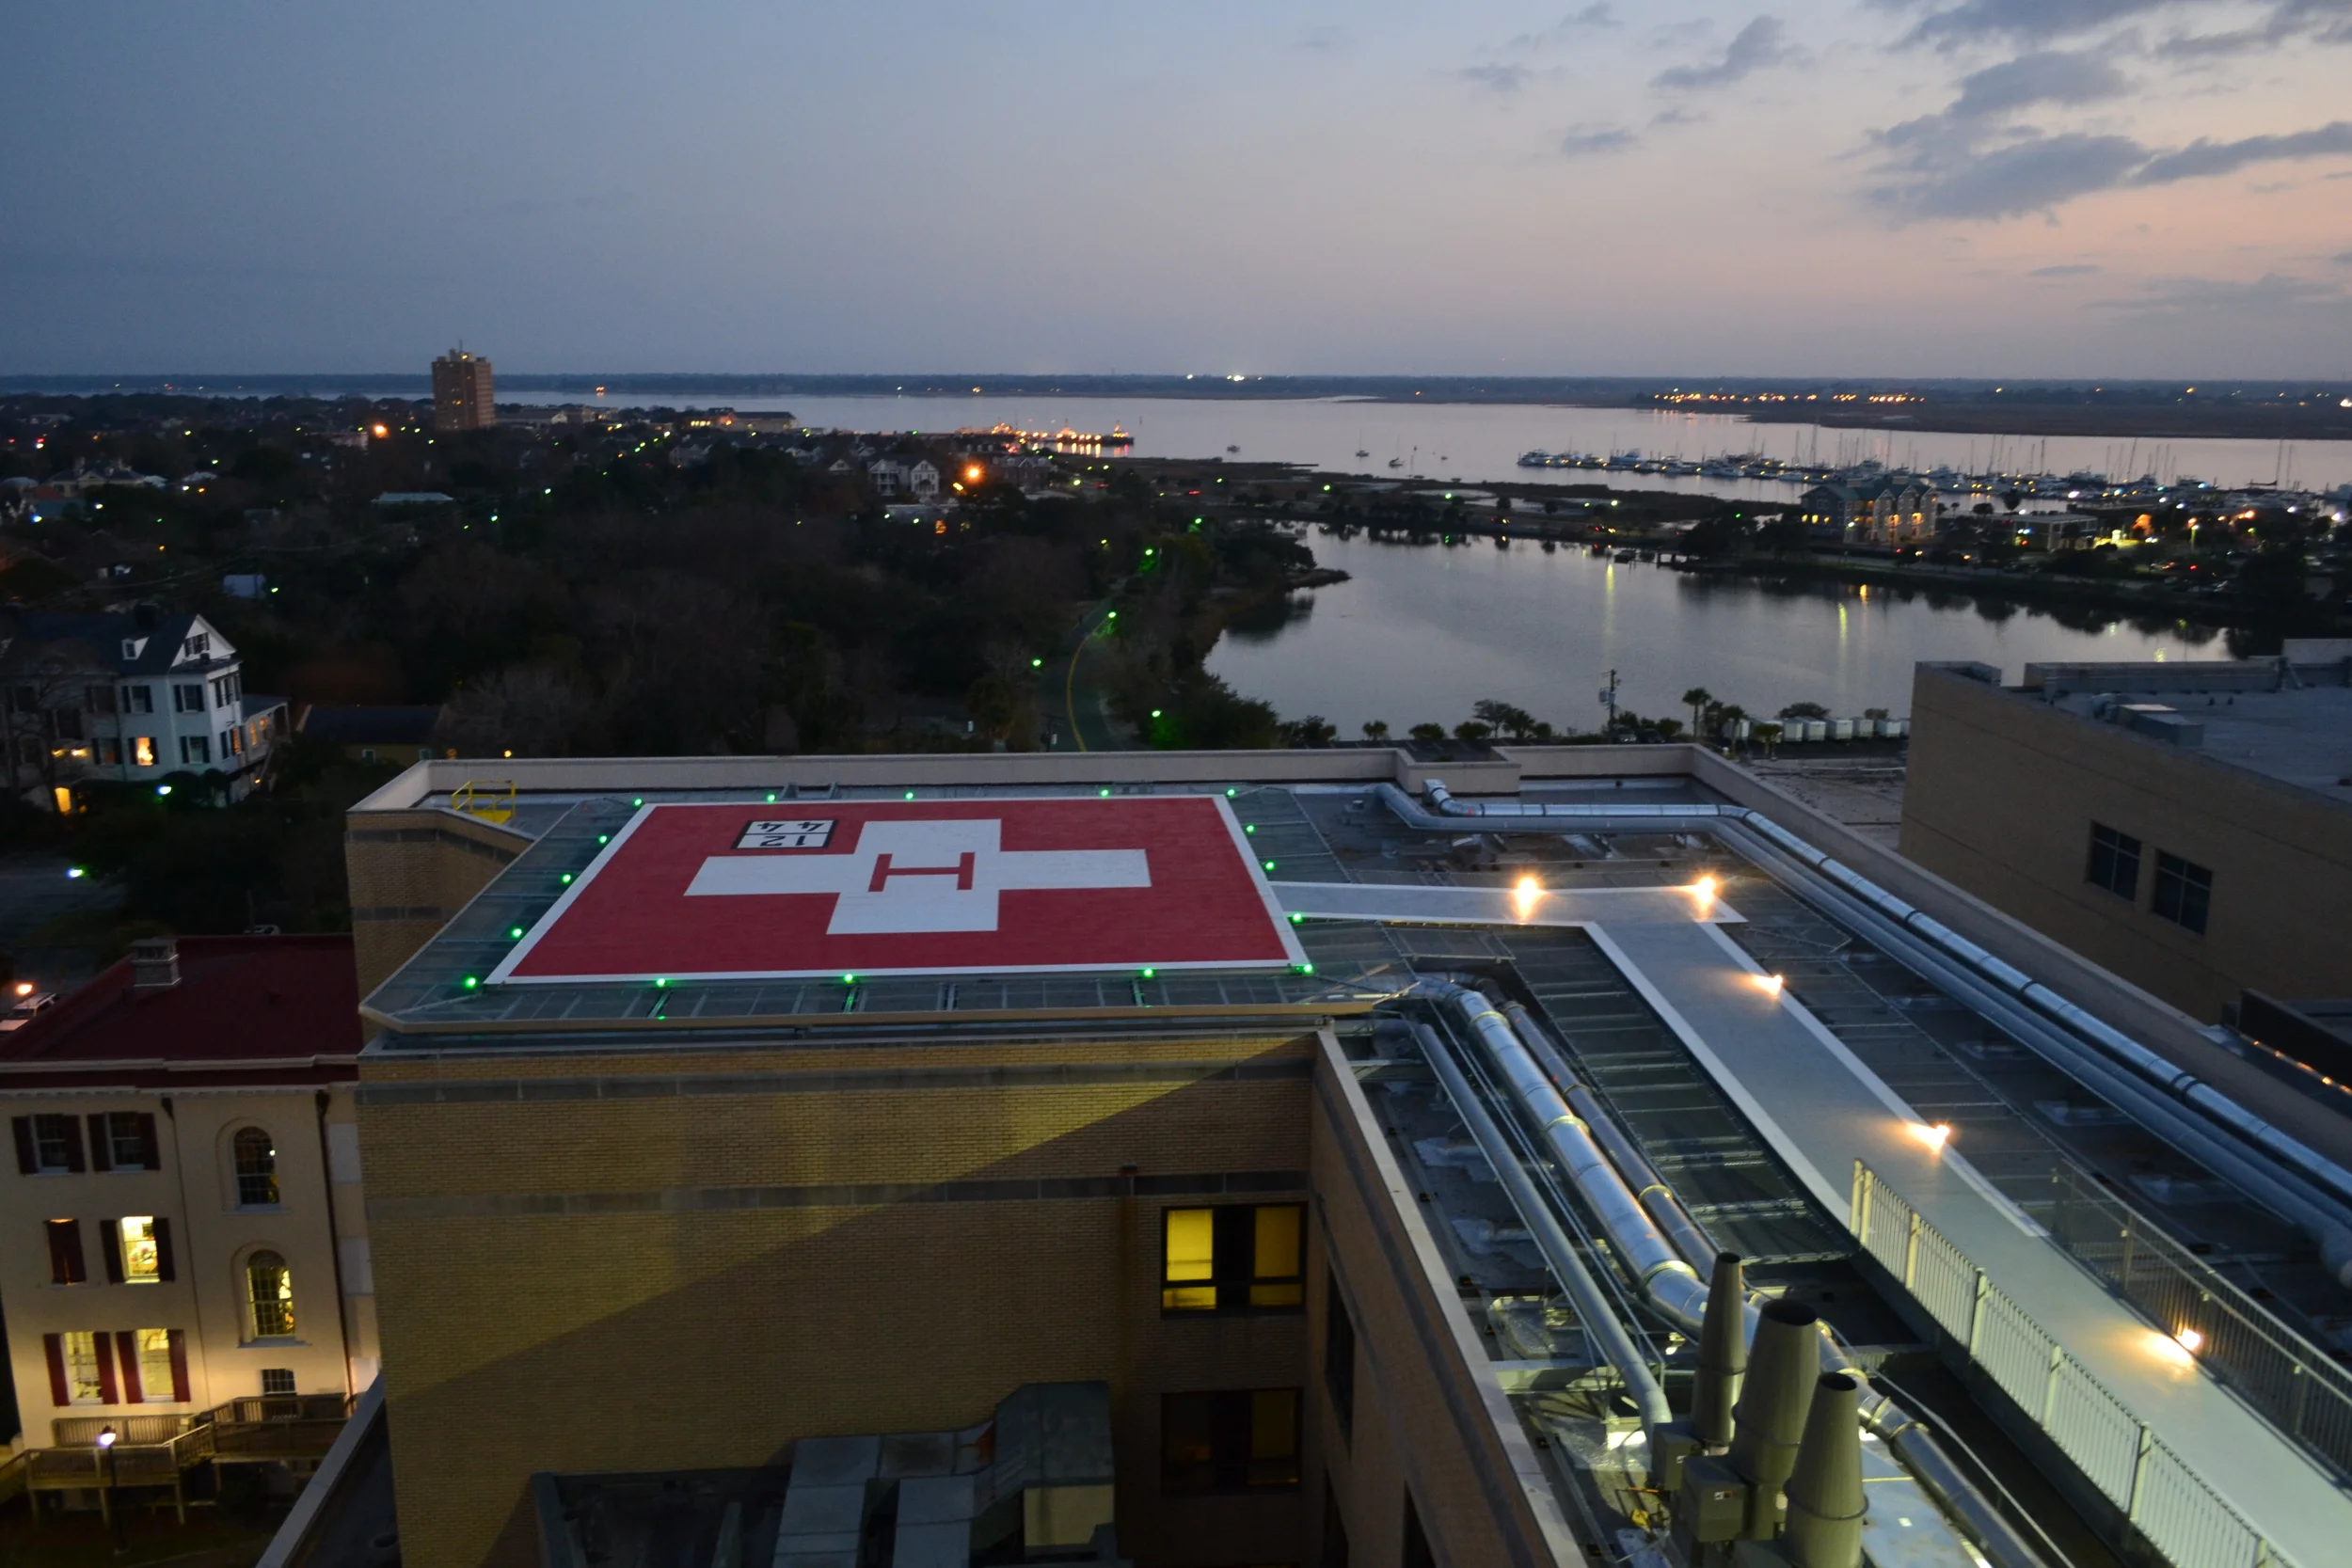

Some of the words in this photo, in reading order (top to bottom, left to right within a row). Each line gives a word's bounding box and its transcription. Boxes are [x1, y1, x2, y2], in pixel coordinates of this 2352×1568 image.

[756, 821, 825, 832] 44
[759, 835, 806, 847] 12
[867, 851, 976, 892] H
